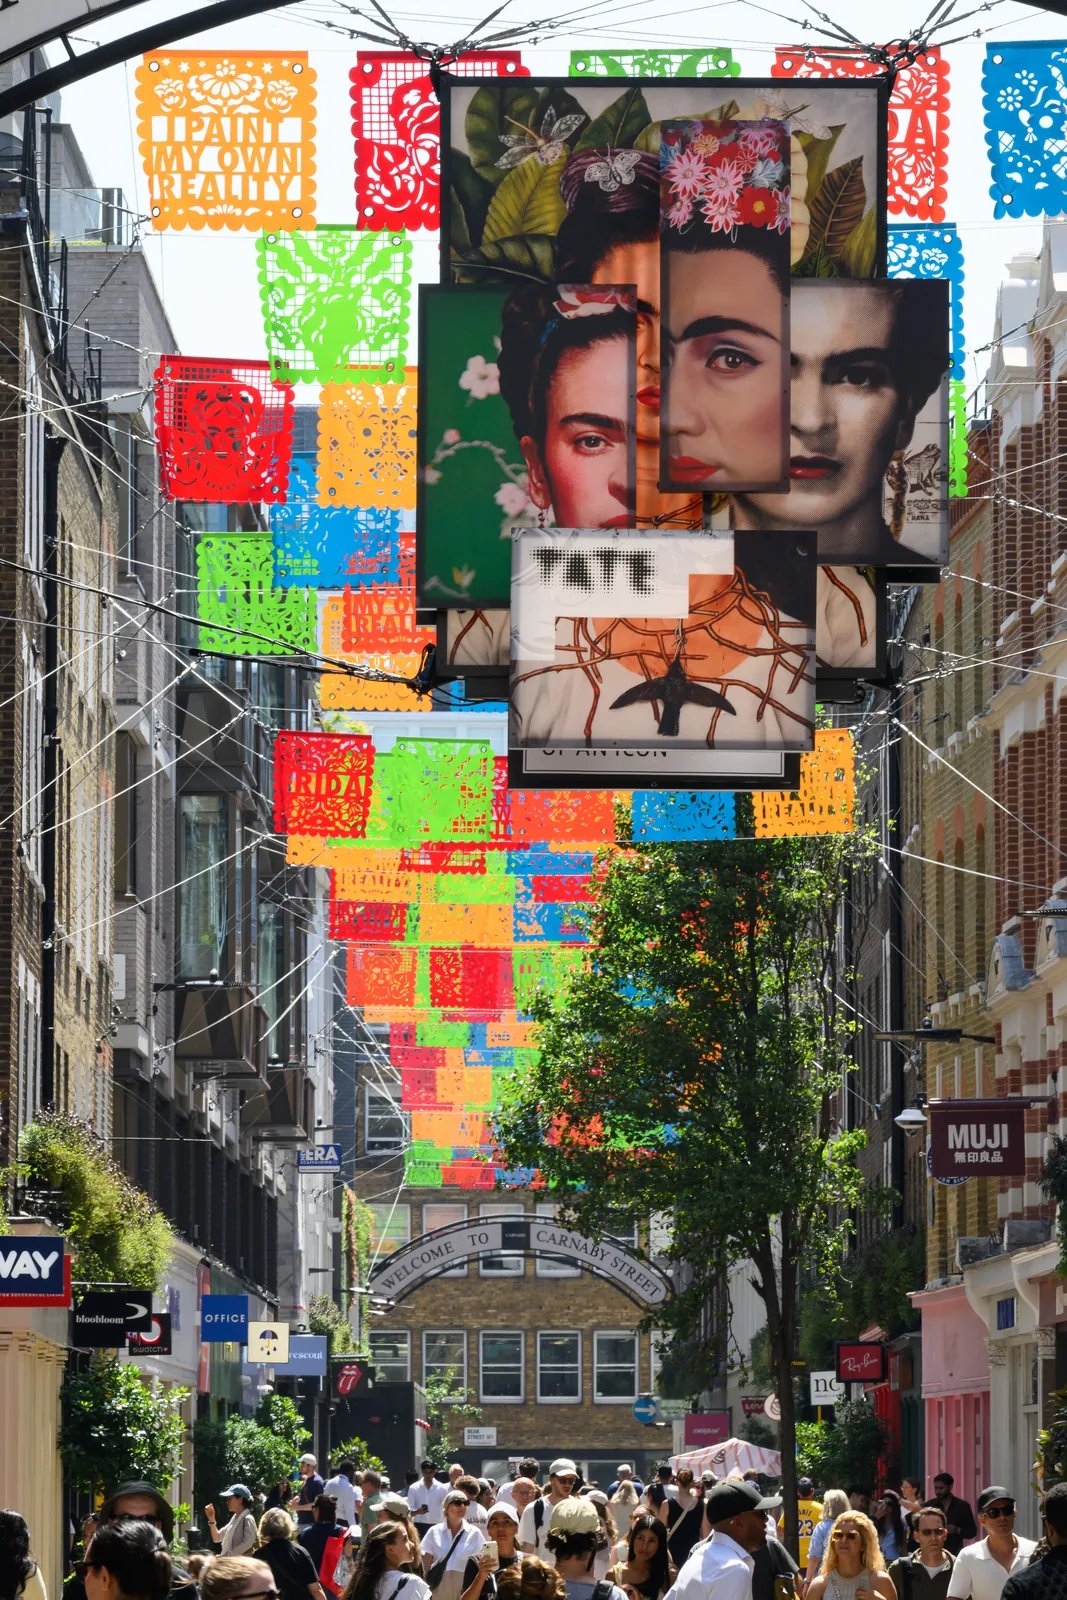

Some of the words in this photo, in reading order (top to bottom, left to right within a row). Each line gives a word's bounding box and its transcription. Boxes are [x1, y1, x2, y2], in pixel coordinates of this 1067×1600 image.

[167, 116, 175, 142] I
[185, 116, 284, 143] PAINT
[154, 145, 205, 172] MY
[217, 145, 298, 173] OWN
[158, 173, 295, 201] REALITY
[947, 1123, 1009, 1149] MUJI
[305, 1147, 339, 1161] ERA
[954, 1151, 1003, 1163] 無印良品
[382, 1241, 455, 1290] WELCOME
[468, 1232, 489, 1246] TO
[536, 1230, 610, 1261] CARNABY
[610, 1256, 662, 1298] STREET
[75, 1314, 124, 1324] bloobloom
[204, 1314, 246, 1323] OFFICE
[132, 1345, 163, 1353] swatch
[842, 1352, 879, 1372] Ray-Ban
[798, 1519, 814, 1537] 23
